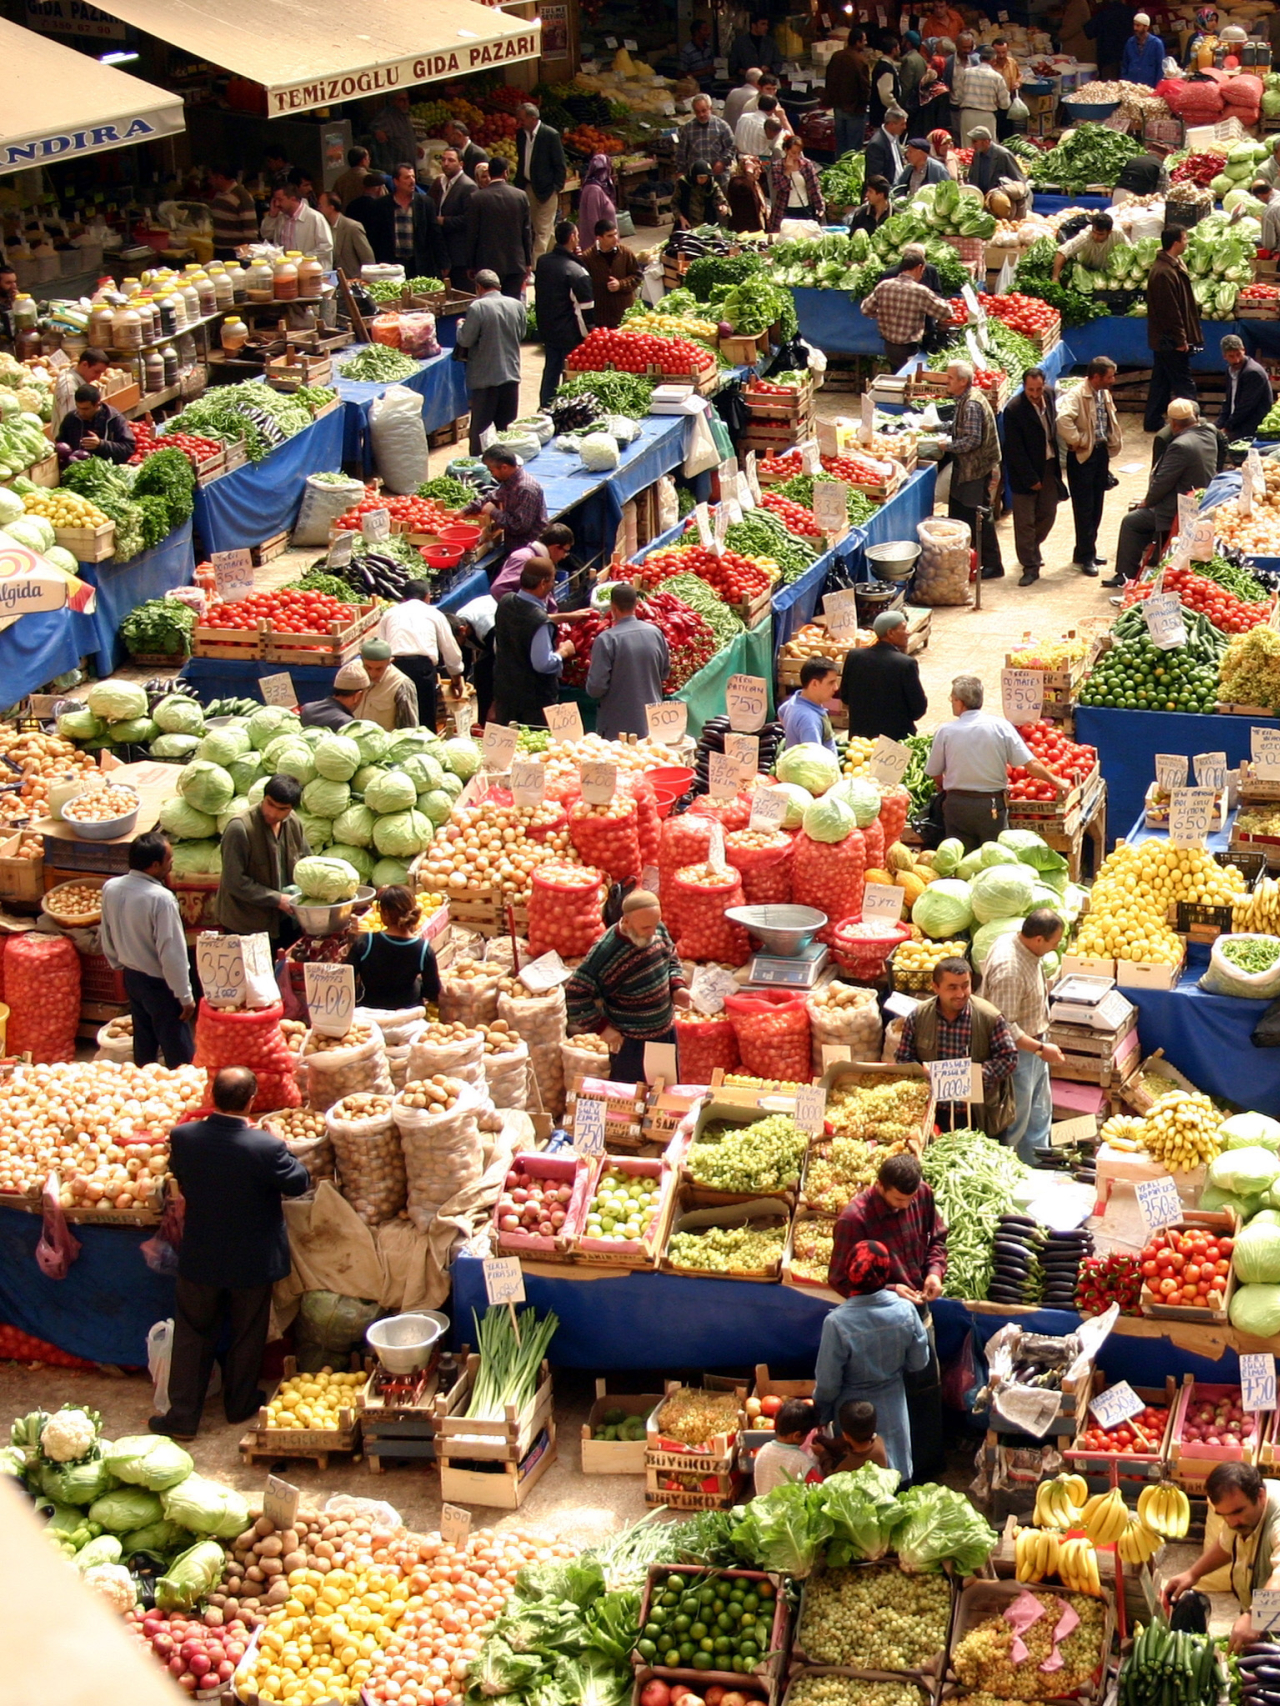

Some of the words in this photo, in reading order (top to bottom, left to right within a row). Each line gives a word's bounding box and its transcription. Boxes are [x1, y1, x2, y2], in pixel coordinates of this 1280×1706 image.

[413, 53, 459, 79] GIDA
[470, 35, 535, 67] PAZARI
[0, 118, 155, 166] NDIRA
[0, 580, 44, 608] lgida
[730, 695, 762, 715] 750
[1004, 688, 1037, 703] 350
[551, 714, 577, 731] 400
[651, 710, 679, 727] 500
[873, 749, 907, 771] 400
[581, 773, 614, 789] 400
[1173, 816, 1207, 830] 650
[866, 894, 877, 908] 5
[201, 952, 246, 988] 350
[307, 980, 352, 1018] 400
[577, 1122, 604, 1151] 750
[1142, 1195, 1170, 1222] 350
[1241, 1375, 1274, 1402] 750
[269, 1480, 295, 1504] 500
[445, 1507, 469, 1523] 500
